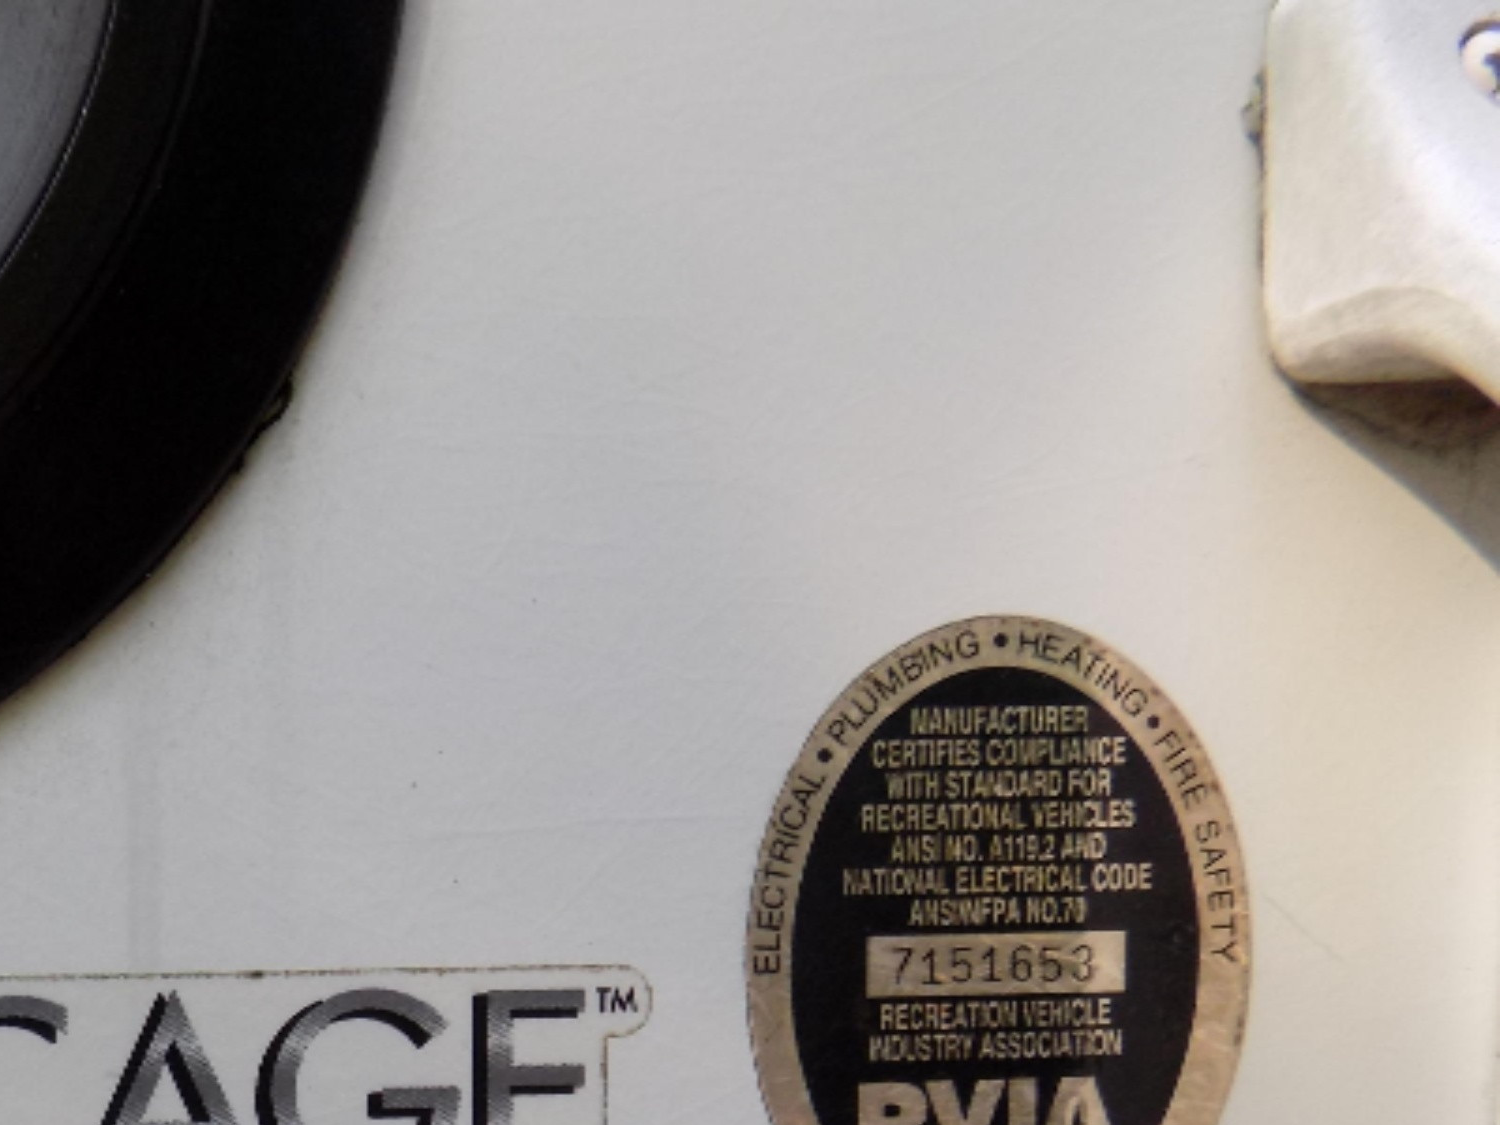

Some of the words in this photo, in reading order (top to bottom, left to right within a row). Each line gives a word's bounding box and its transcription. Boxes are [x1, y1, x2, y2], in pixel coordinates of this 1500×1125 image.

[830, 629, 981, 748] PLUMBING
[1017, 630, 1150, 718] HEATING
[910, 705, 1088, 736] MANUFACTURER
[871, 739, 982, 768] CERTIFIES
[986, 736, 1127, 767] COMPLIANCE
[886, 772, 940, 799] WITH
[944, 770, 1062, 798] STANDARD
[1066, 768, 1111, 797] FOR
[861, 803, 1027, 833] RECREATIONAL
[1032, 800, 1135, 830] VEHICLES
[1060, 832, 1108, 860] AND
[1153, 729, 1208, 810] FIRE
[1193, 820, 1237, 965] SAFETY
[754, 768, 827, 975] ELECTRICAL
[842, 867, 949, 896] NATIONAL
[955, 865, 1086, 895] ELECTRICAL
[1091, 863, 1153, 891] CODE
[893, 944, 1096, 987] 7151653
[880, 1002, 1018, 1031] RECREATION
[1022, 998, 1111, 1027] VEHICLE
[868, 1033, 974, 1061] INDUSTRY
[978, 1029, 1123, 1059] ASSOCIATION
